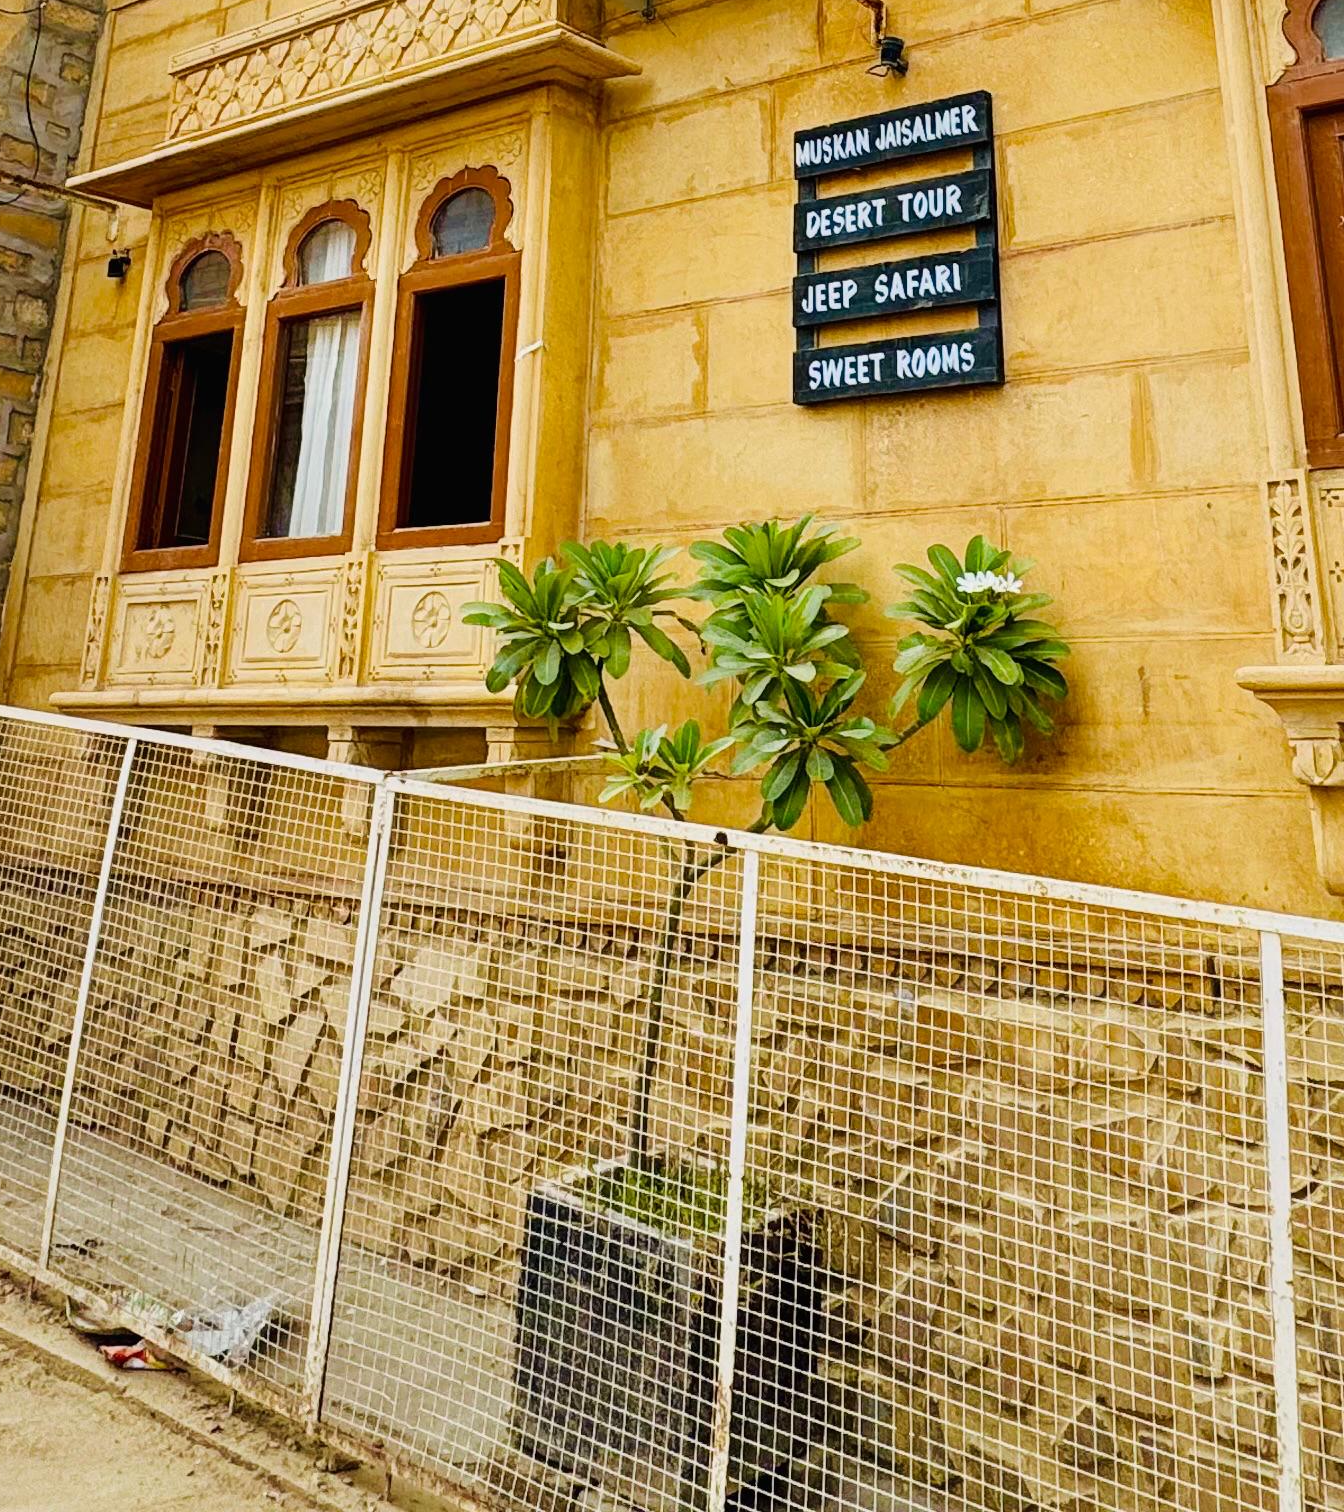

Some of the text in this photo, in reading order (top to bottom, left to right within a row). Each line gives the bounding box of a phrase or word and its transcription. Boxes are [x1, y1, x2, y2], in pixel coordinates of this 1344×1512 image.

[796, 104, 980, 168] MUSKAN JAISALMER
[806, 184, 963, 239] DESERT TOUR
[801, 262, 961, 314] JEEP SAFARI
[808, 342, 975, 391] SWEET ROOMS
